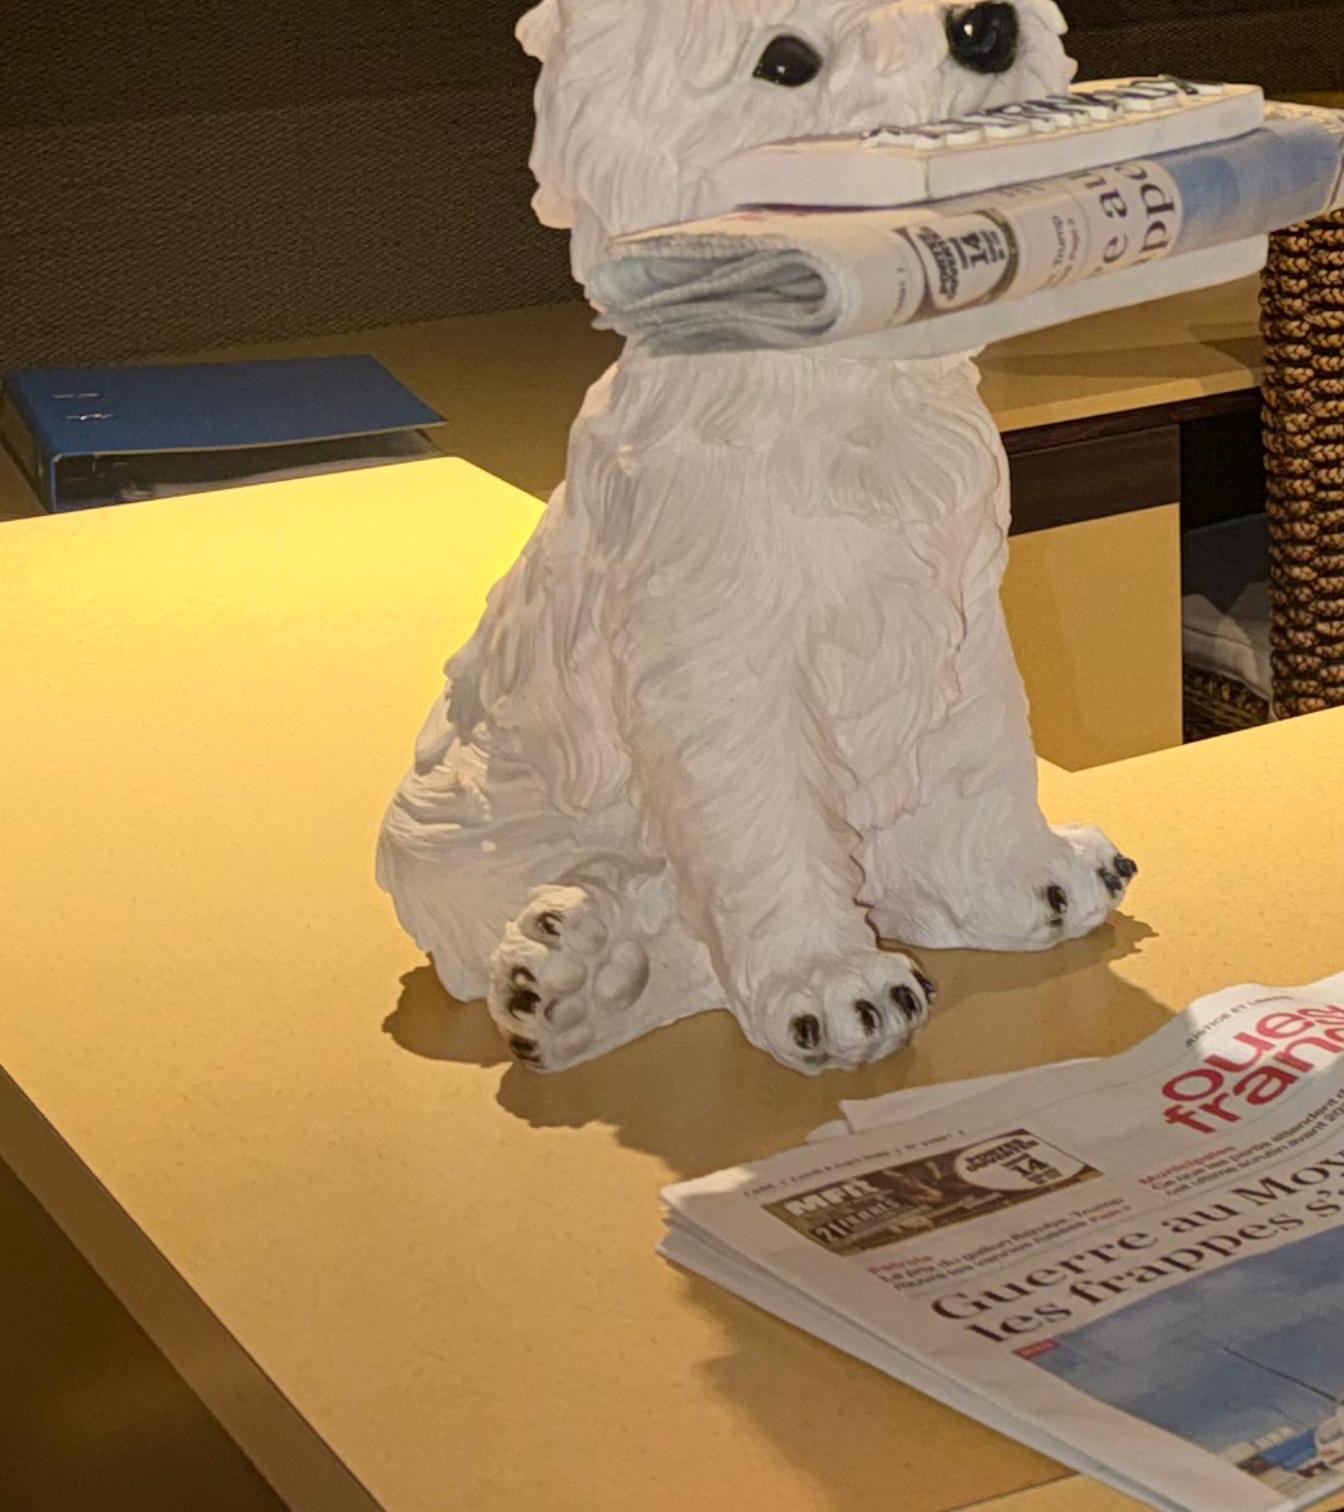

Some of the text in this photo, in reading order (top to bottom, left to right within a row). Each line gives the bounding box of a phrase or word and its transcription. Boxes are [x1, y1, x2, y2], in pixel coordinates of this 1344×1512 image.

[1012, 1158, 1051, 1178] 14
[931, 1228, 1159, 1323] Guerre
[1162, 1193, 1242, 1233] au
[965, 1298, 1072, 1344] les
[1070, 1212, 1305, 1315] frappes
